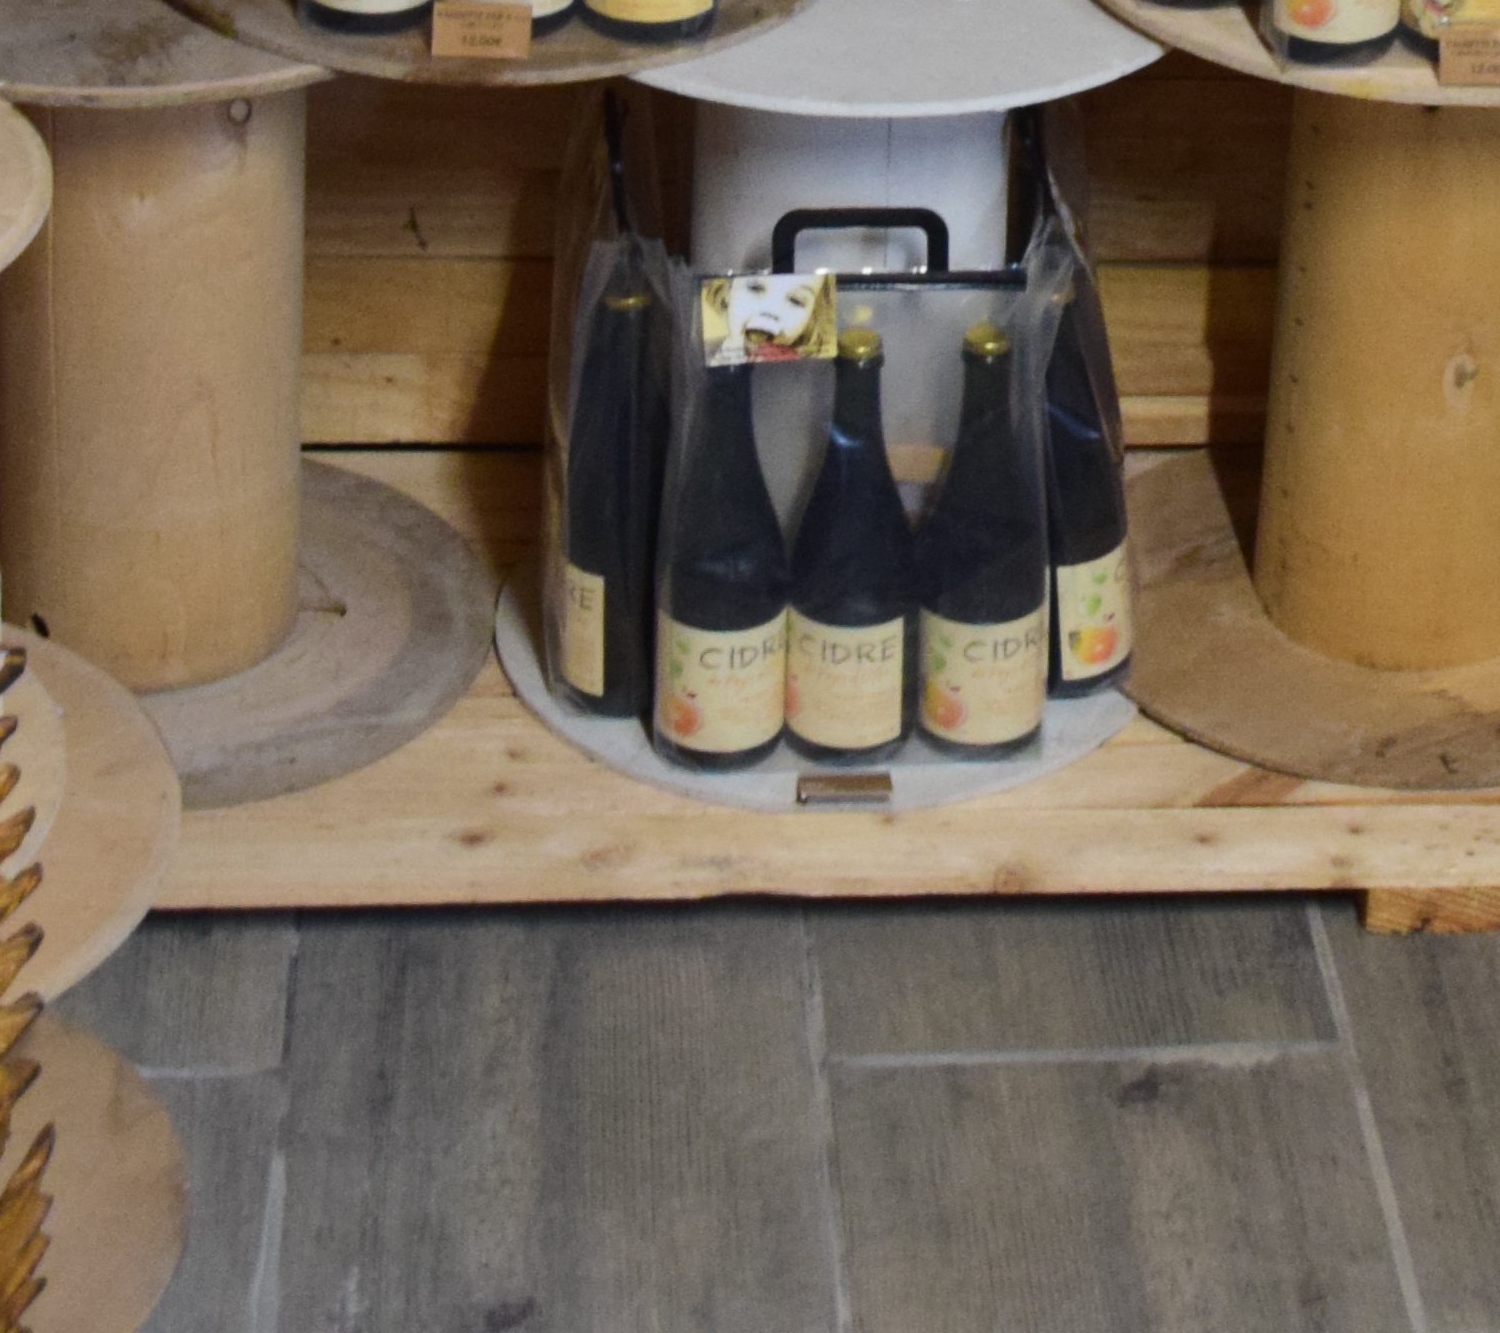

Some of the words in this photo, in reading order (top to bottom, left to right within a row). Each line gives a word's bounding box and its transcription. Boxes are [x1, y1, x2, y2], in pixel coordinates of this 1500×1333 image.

[700, 637, 786, 671] CIDR
[799, 633, 897, 664] CIDRE
[963, 627, 1041, 664] CIDR
